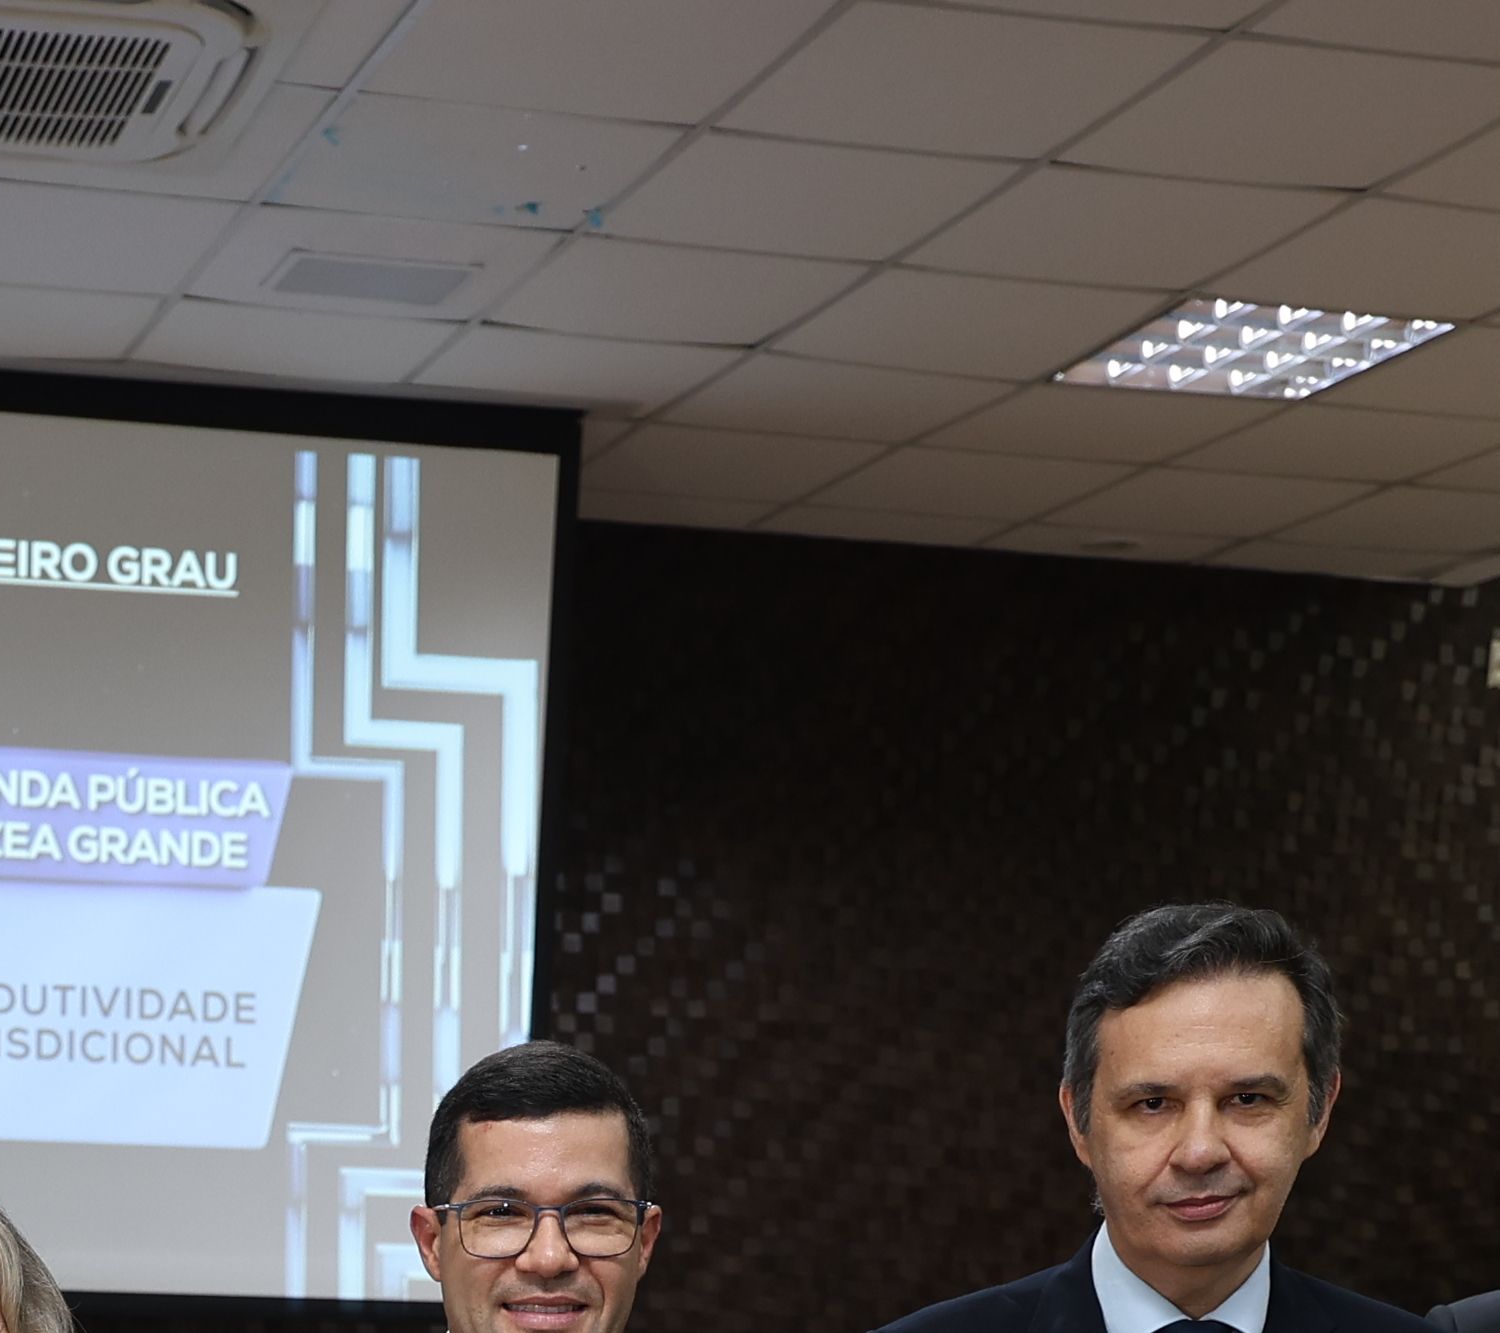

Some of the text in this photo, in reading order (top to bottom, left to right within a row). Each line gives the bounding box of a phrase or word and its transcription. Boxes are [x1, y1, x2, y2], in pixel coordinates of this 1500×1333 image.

[107, 546, 237, 590] GRAU
[88, 768, 270, 819] PÚBLICA
[68, 826, 249, 869] GRANDE
